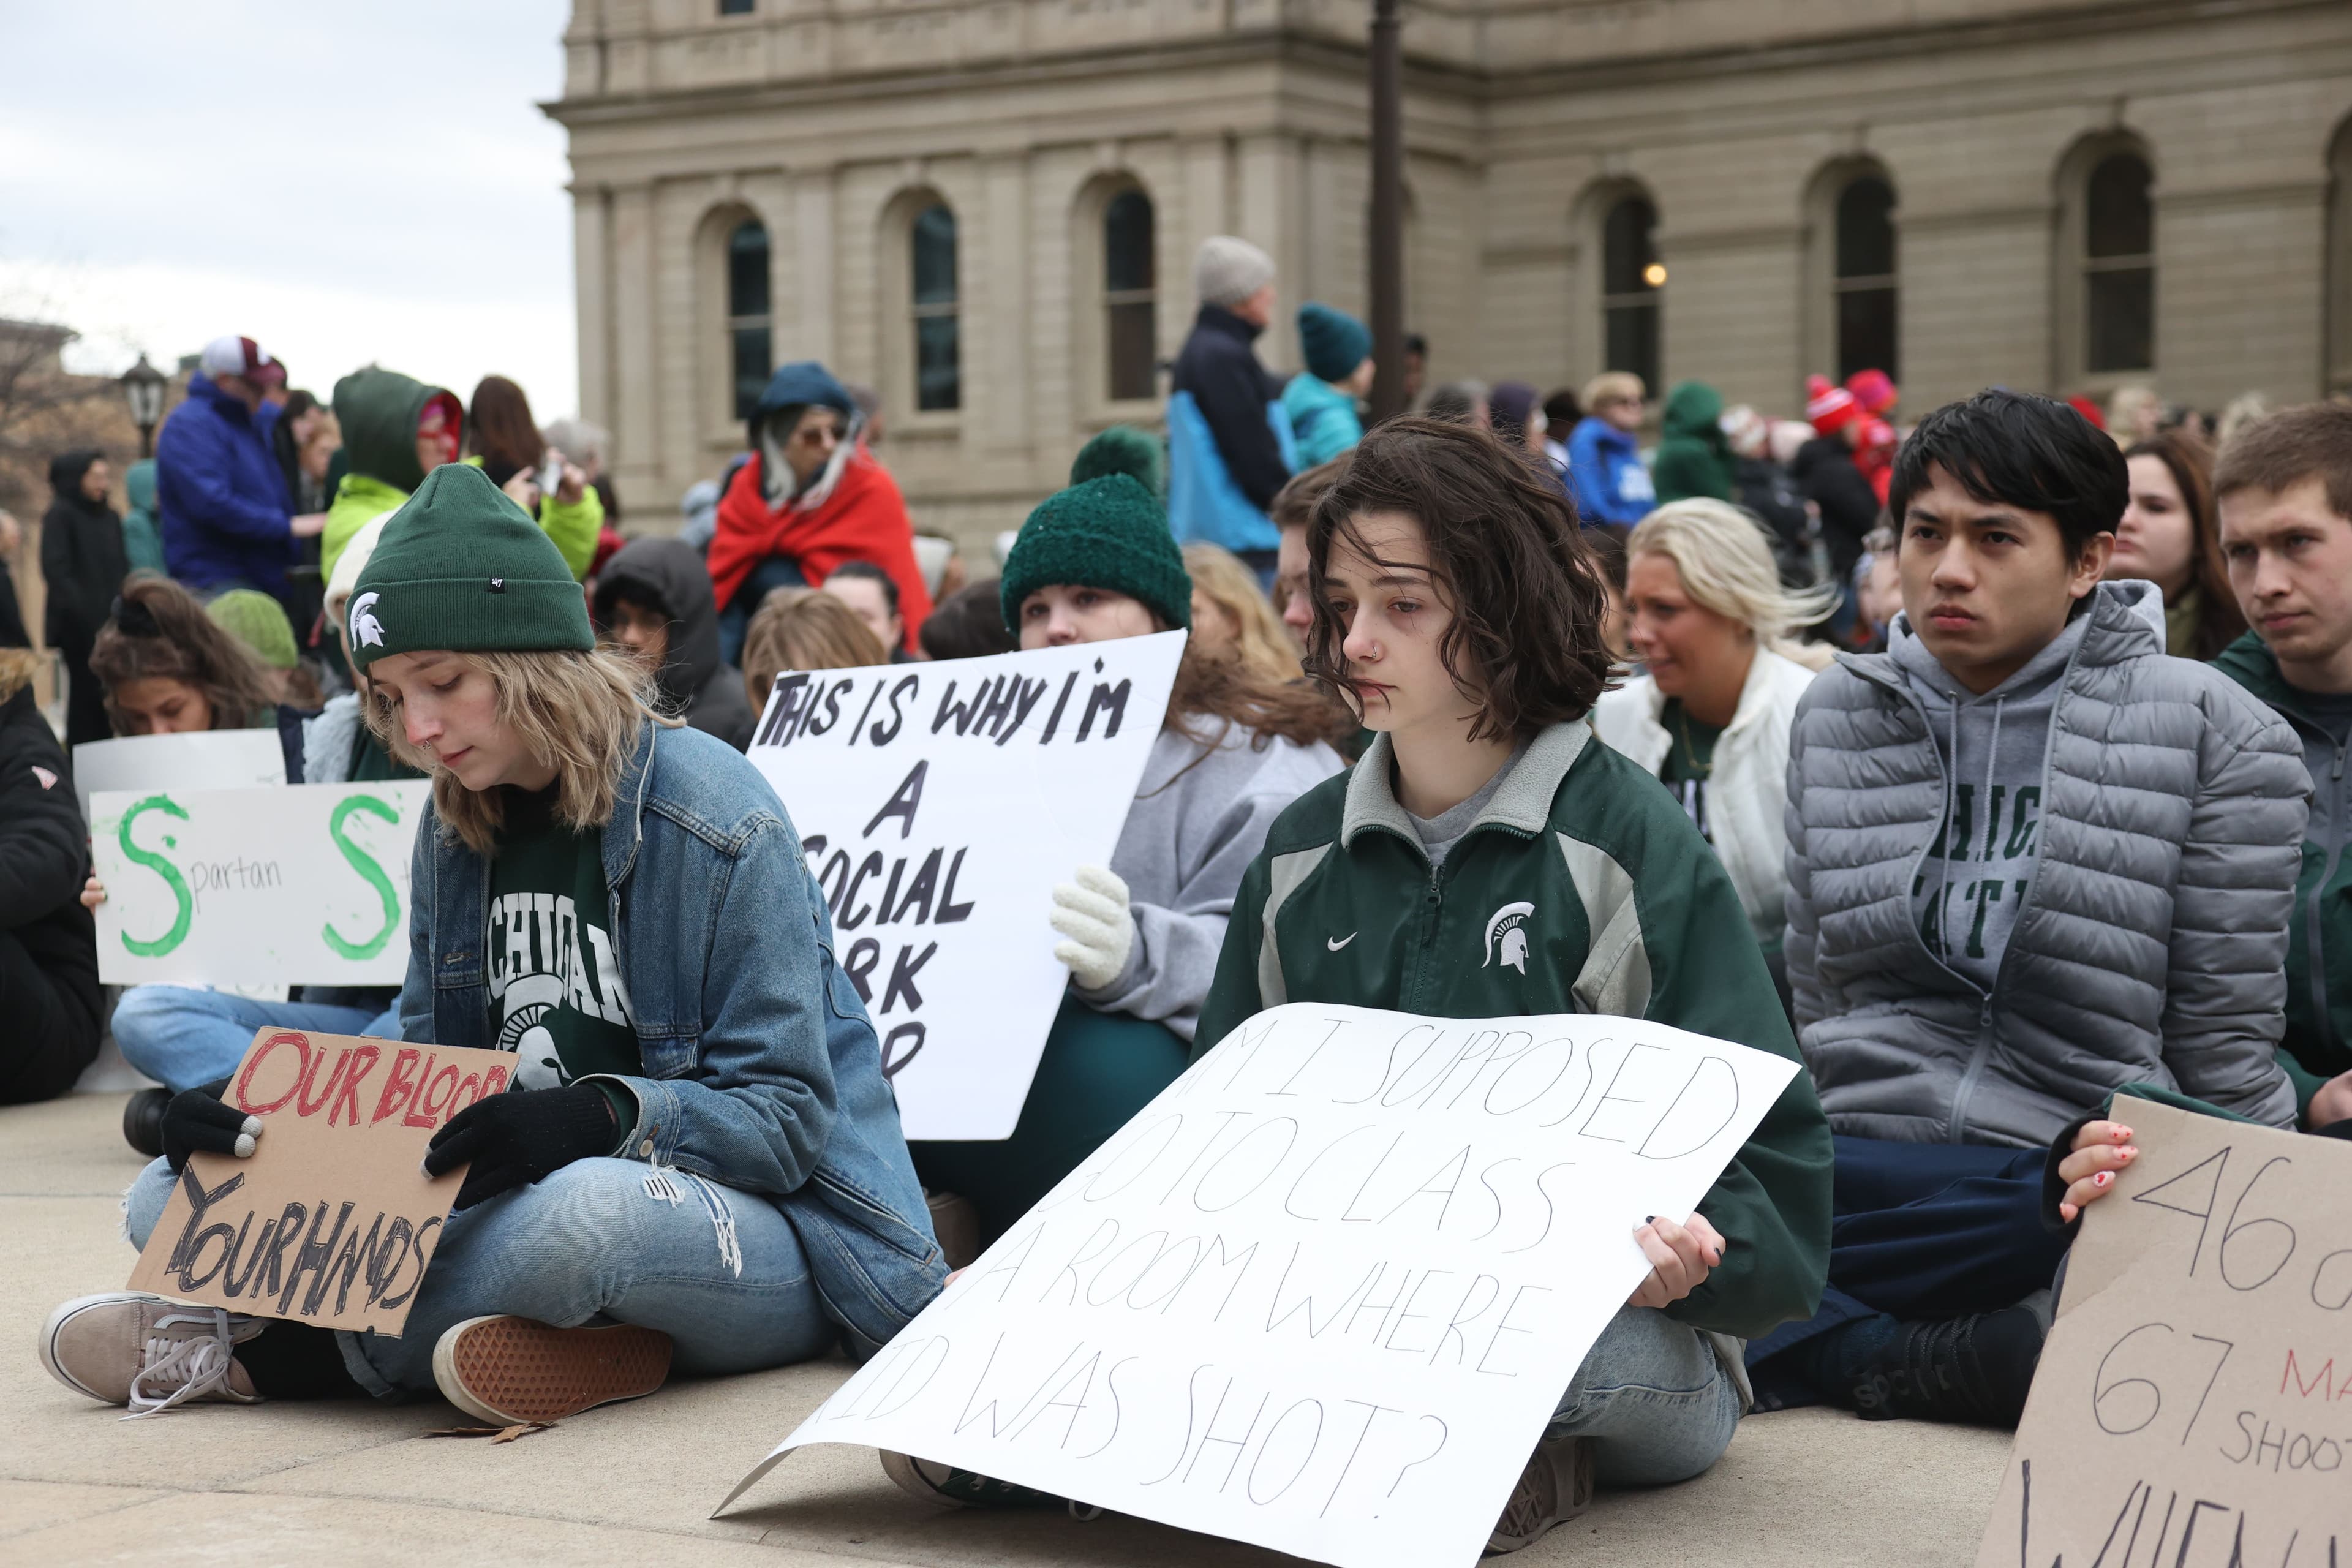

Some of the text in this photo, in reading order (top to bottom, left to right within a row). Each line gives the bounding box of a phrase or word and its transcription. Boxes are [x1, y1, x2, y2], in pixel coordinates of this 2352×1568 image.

[757, 672, 853, 747] THIS
[848, 674, 919, 747] IS
[931, 672, 1048, 747] WHY
[862, 760, 929, 839] A
[236, 1033, 382, 1128] OUR
[1265, 1019, 1352, 1096] I
[1332, 1024, 1739, 1159] SUPPOSED
[1284, 1125, 1576, 1254] CLASS
[2132, 1146, 2291, 1291] 46
[944, 1219, 1553, 1378] A ROOM WHERE
[954, 1331, 1139, 1460] WAS
[1140, 1363, 1448, 1520] SHOT?
[2094, 1322, 2234, 1446] 67
